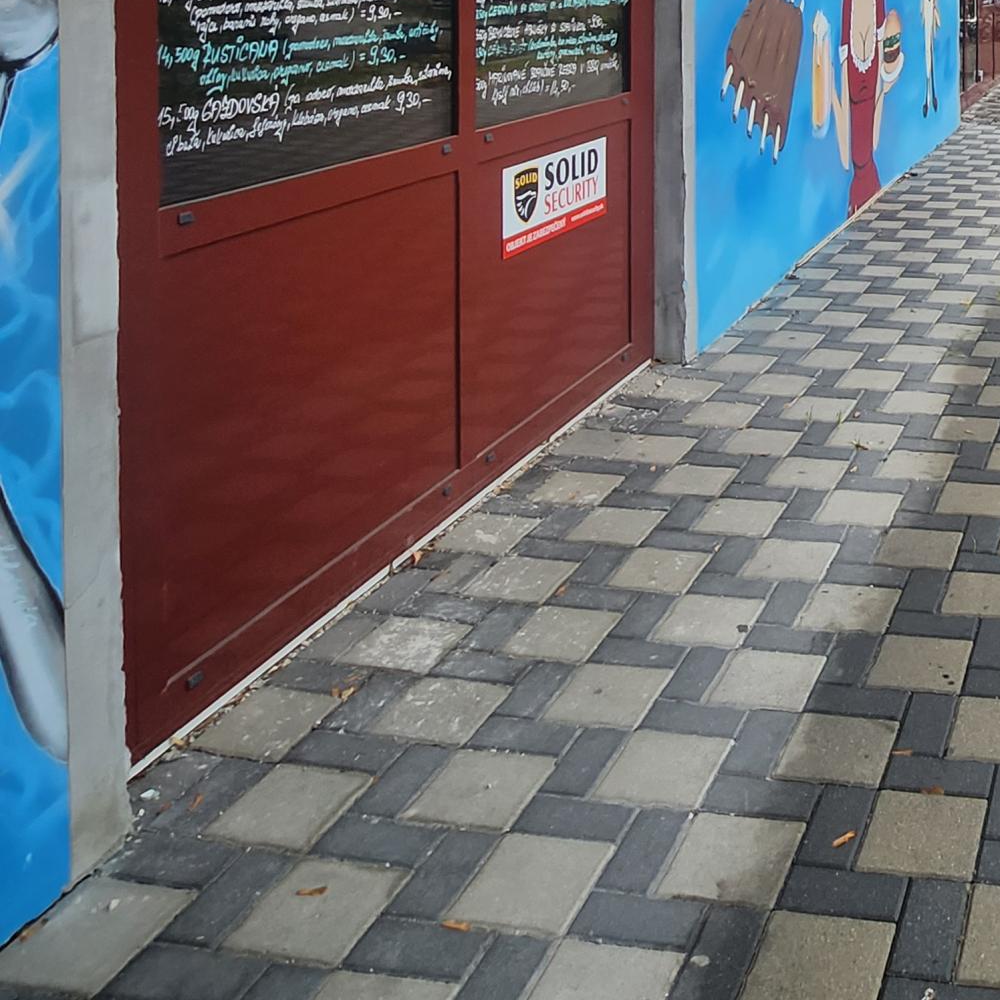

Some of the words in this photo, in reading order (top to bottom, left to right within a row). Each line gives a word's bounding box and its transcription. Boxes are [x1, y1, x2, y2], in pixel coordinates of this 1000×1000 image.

[514, 171, 538, 190] SOLID
[544, 147, 599, 191] SOLID
[544, 175, 599, 216] SECURITY
